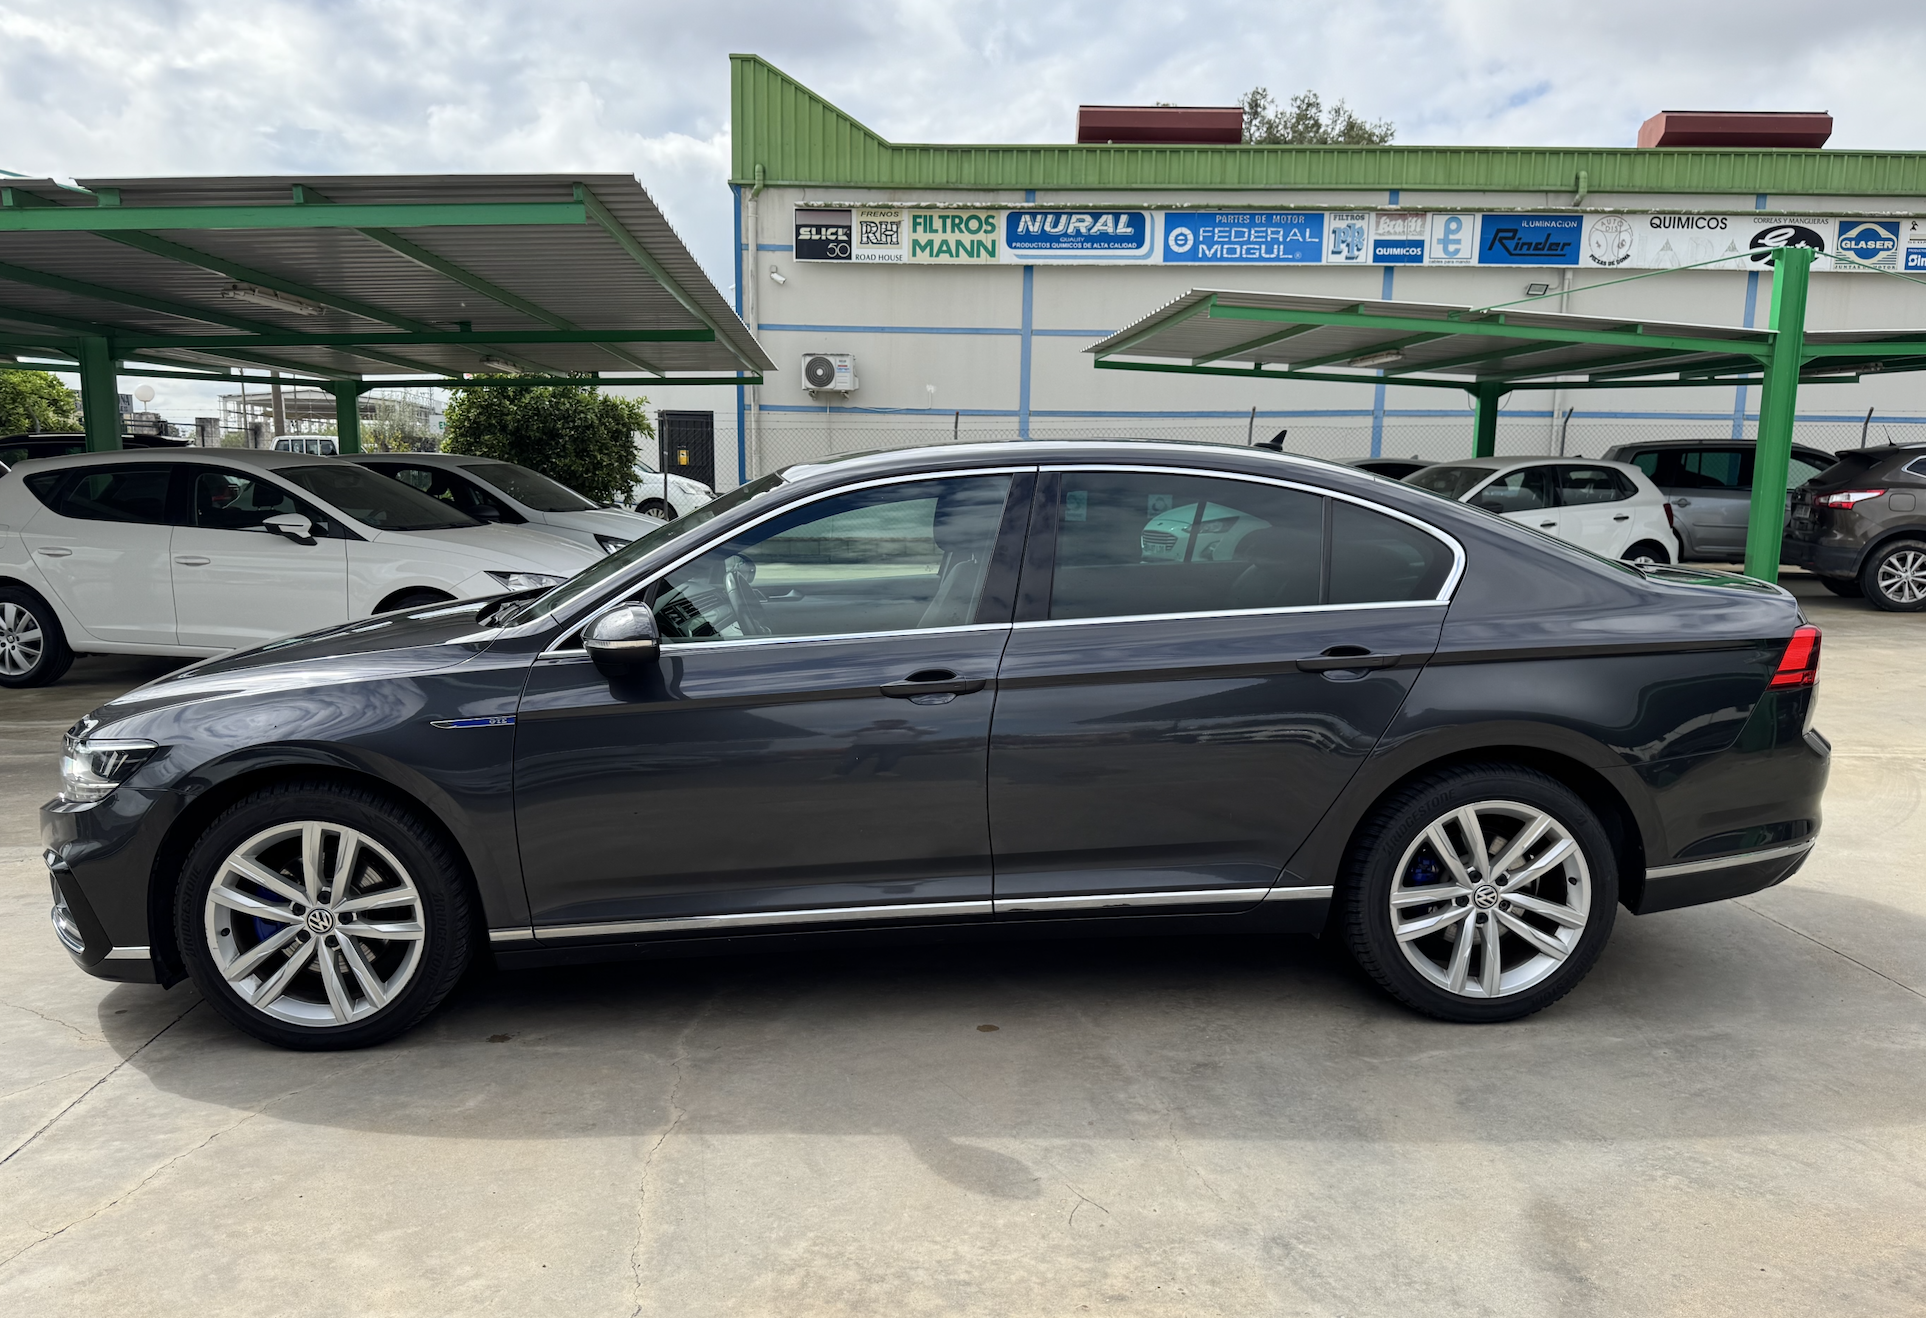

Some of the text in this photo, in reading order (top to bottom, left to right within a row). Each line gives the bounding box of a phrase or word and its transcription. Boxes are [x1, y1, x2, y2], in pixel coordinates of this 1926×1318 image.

[912, 213, 997, 234] FILTROS
[1017, 214, 1134, 236] NURAL
[1216, 215, 1305, 224] PARTES DE MOTOR
[1601, 218, 1624, 227] AUTO
[1649, 216, 1728, 230] QUIMICOS
[859, 221, 900, 245] RH
[1199, 227, 1319, 242] FEDERAL
[912, 239, 997, 259] MANN
[1487, 228, 1571, 256] Rinder
[1841, 240, 1894, 249] GLASER
[827, 243, 850, 257] 50
[1198, 244, 1293, 258] MOGUL
[1376, 247, 1422, 255] QUIMICOS
[878, 254, 903, 262] HOUSE
[1383, 788, 1457, 857] BRIDGESTONE
